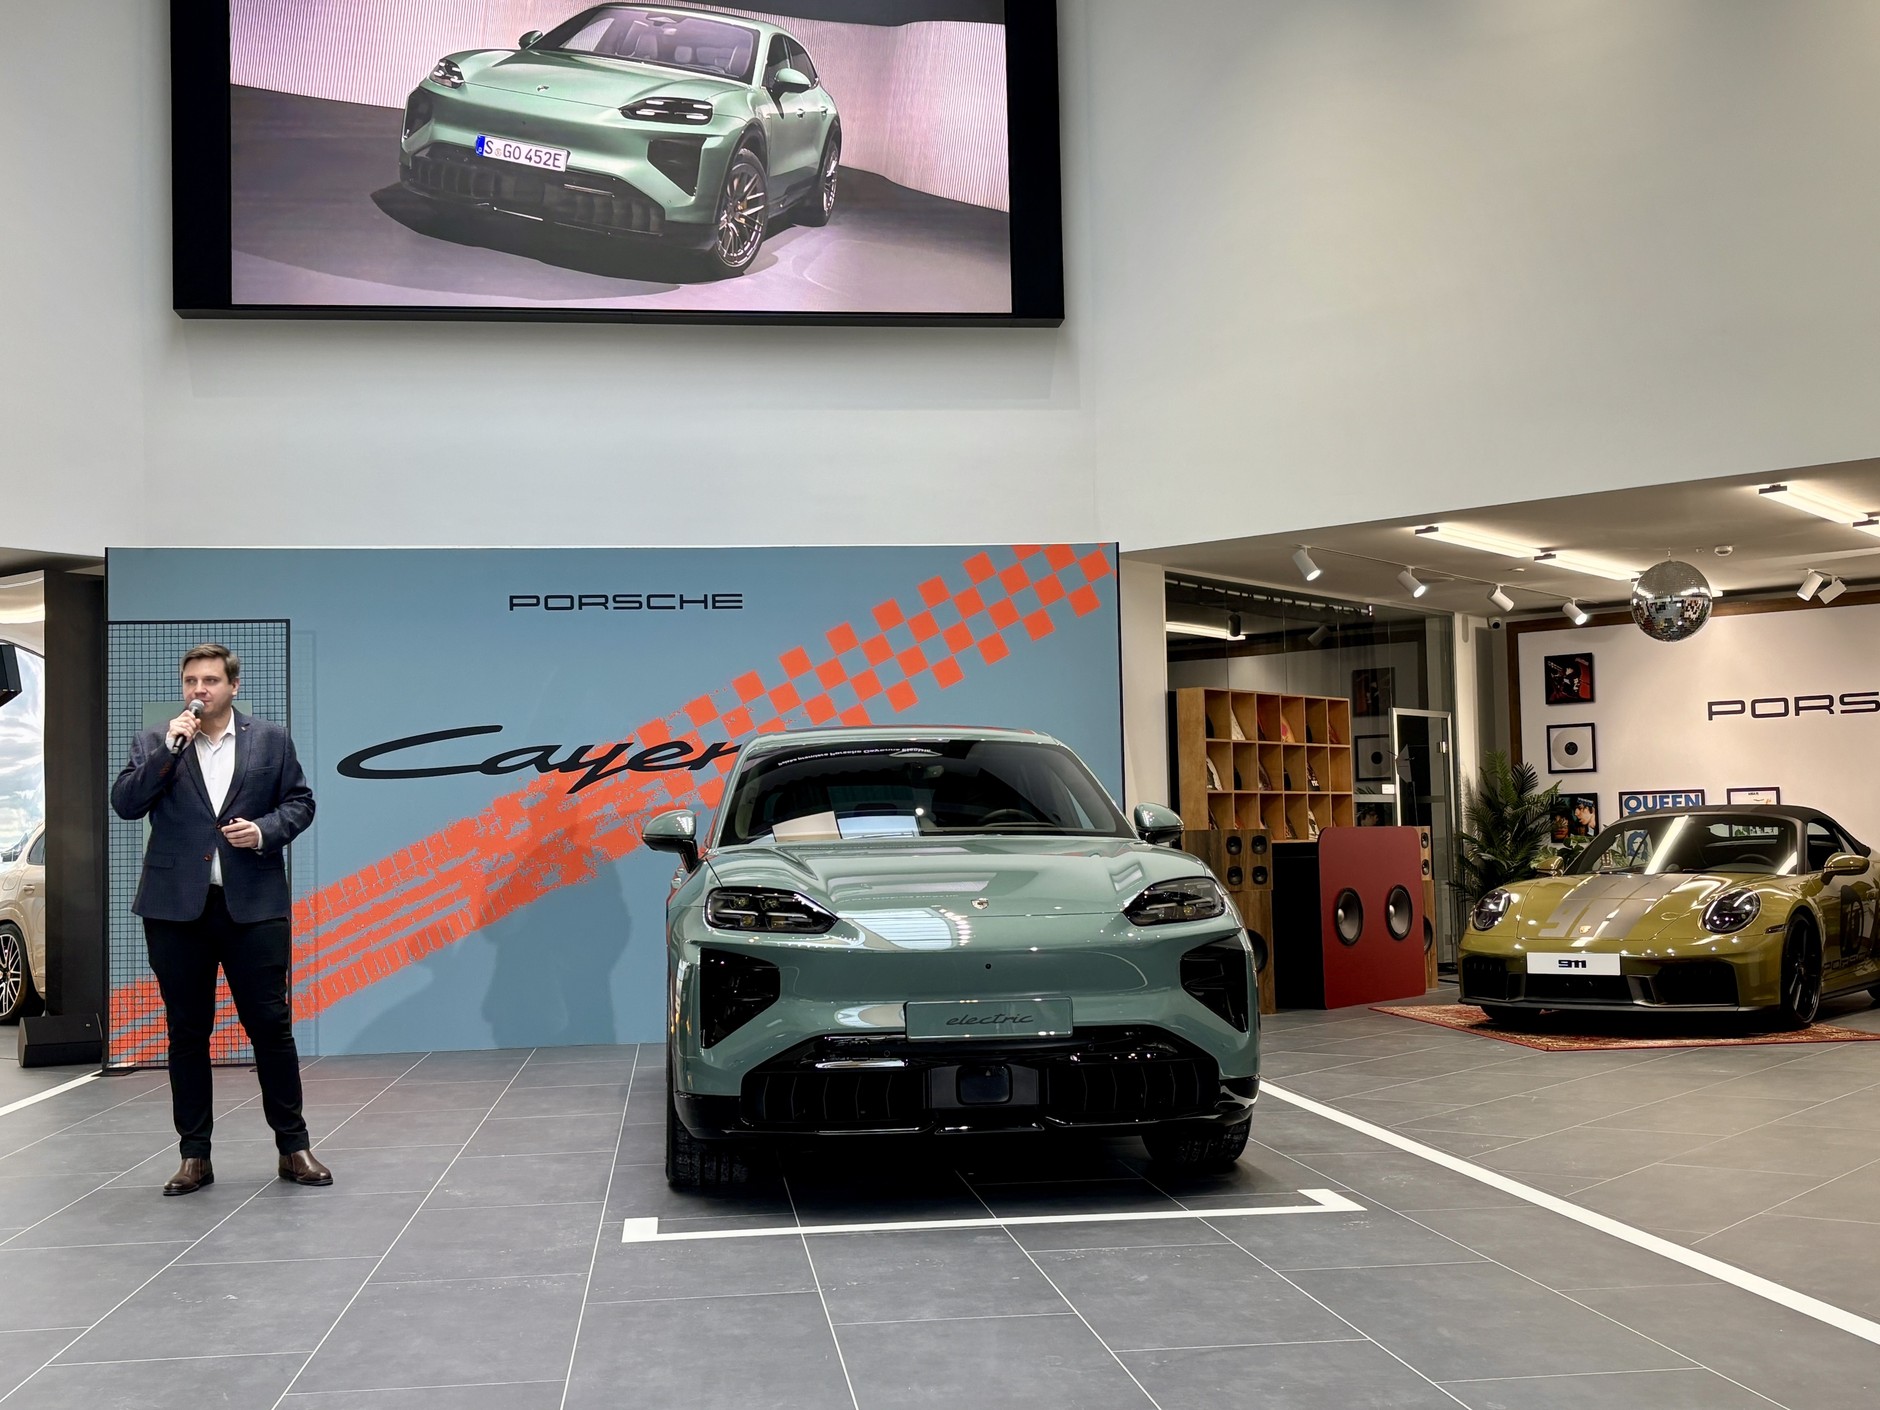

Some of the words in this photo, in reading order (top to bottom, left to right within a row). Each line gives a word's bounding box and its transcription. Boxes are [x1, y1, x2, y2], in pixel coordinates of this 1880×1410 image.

[485, 140, 494, 155] S
[503, 143, 522, 160] GO
[525, 148, 562, 169] 452E
[509, 593, 743, 611] PORSCHE
[1624, 793, 1700, 813] QUEEN
[1558, 959, 1587, 969] 911
[946, 1013, 1034, 1026] electric
